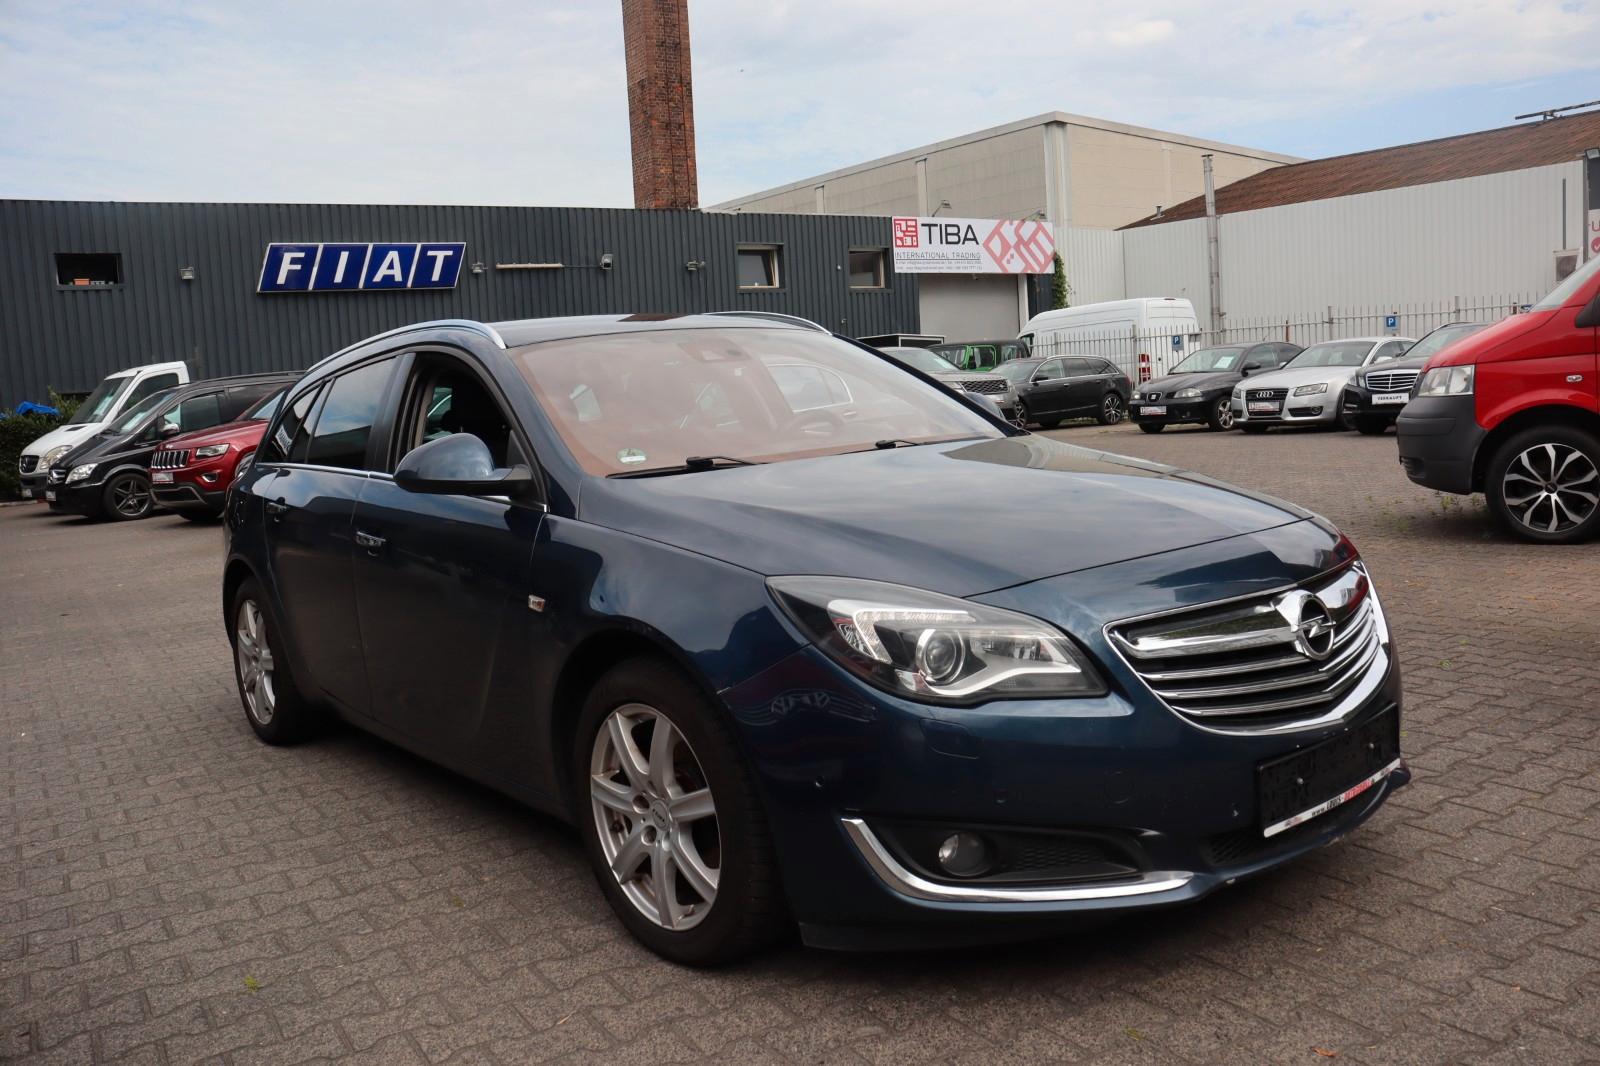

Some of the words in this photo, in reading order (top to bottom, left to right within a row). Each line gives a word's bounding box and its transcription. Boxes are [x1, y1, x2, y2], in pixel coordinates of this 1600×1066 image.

[921, 223, 979, 245] TIBA
[895, 251, 949, 259] INTERNATIONAL
[952, 251, 981, 259] TRADING
[276, 250, 453, 285] FIAT
